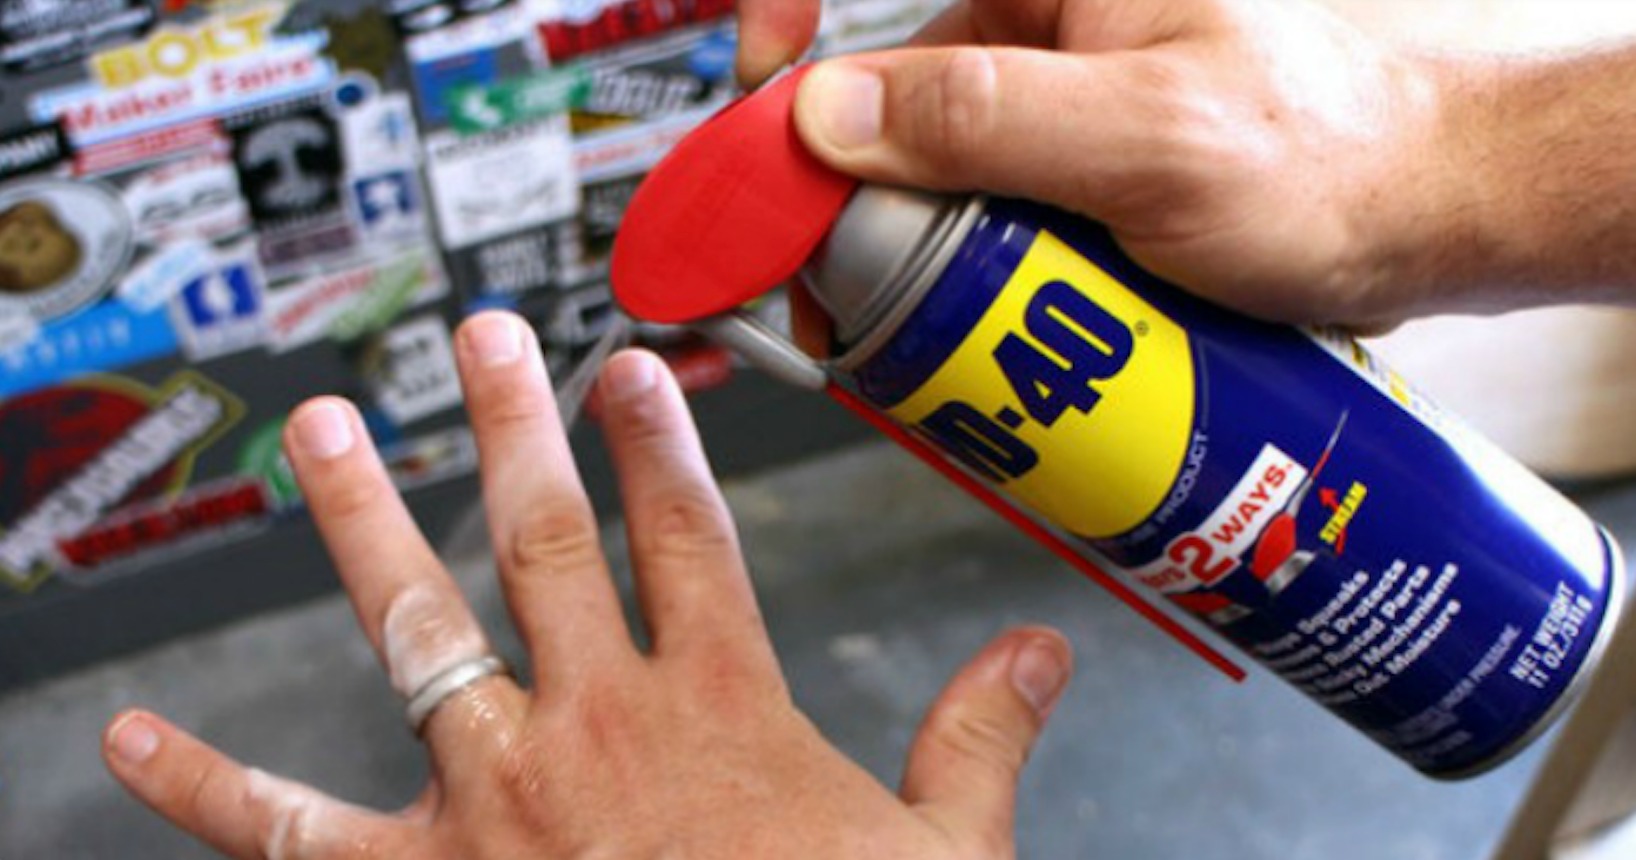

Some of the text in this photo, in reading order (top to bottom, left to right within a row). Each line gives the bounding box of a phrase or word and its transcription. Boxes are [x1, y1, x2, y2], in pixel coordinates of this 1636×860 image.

[98, 13, 274, 88] BOLT
[60, 84, 193, 132] Maker
[1157, 430, 1209, 526] PRODUCT
[1319, 481, 1367, 544] STREAM
[1168, 534, 1236, 585] 2
[1333, 559, 1407, 634] Protects
[1297, 570, 1369, 634] Squeaks
[1323, 616, 1386, 667] Rusted
[1379, 565, 1430, 619] Parts
[1361, 562, 1459, 666] Mechanisms
[1384, 599, 1461, 674] Moisture
[1509, 580, 1575, 680] NET WEIGHT
[1527, 669, 1549, 688] 11
